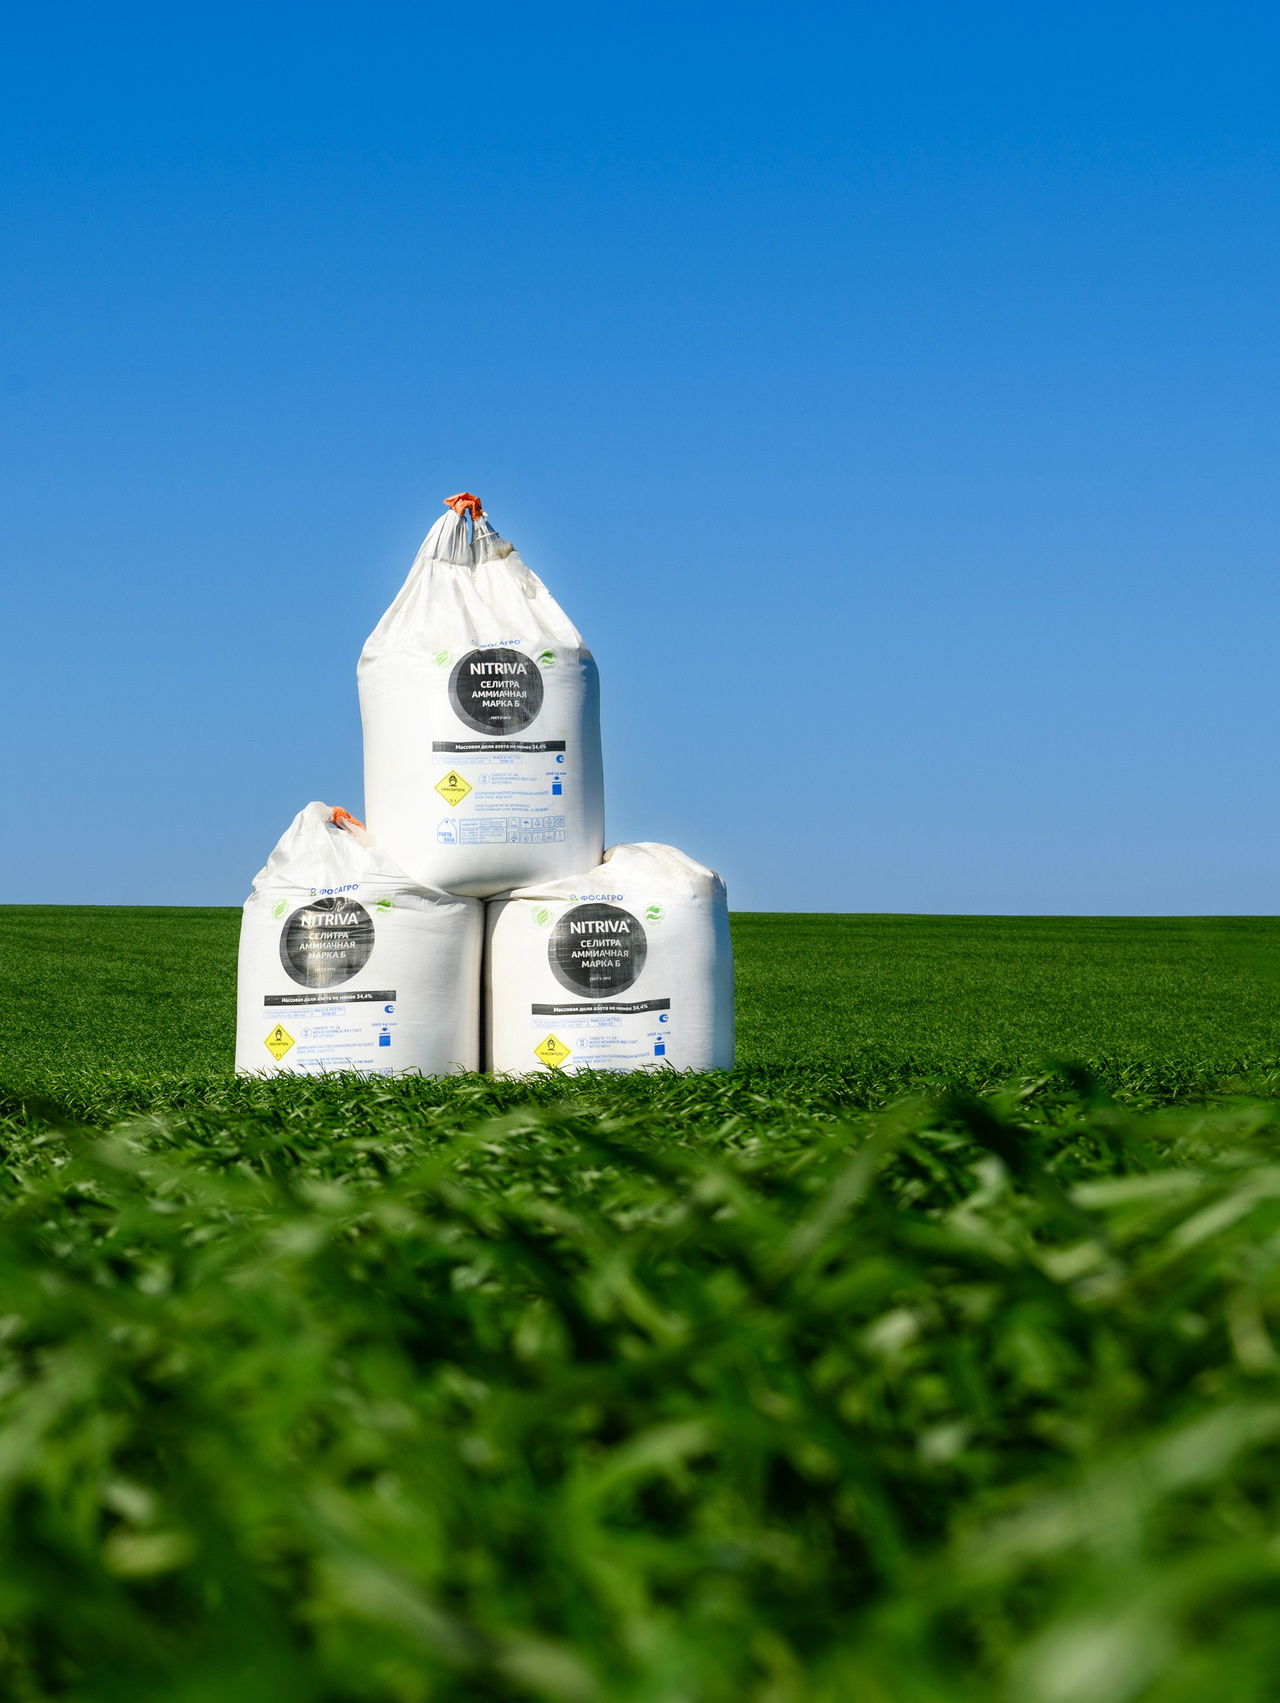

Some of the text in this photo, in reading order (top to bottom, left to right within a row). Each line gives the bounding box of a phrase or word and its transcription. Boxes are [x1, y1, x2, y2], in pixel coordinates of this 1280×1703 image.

[470, 663, 527, 675] NITRIVA
[480, 681, 520, 689] СЕЛИТРА
[472, 691, 527, 699] АММИАЧНАЯ
[482, 700, 513, 708] МАРКА
[319, 884, 359, 895] ФОСАГРО
[301, 912, 359, 927] NITRIVA
[570, 920, 630, 934] NITRIVA
[309, 931, 349, 940] СЕЛИТРА
[299, 941, 356, 950] АММИАЧНАЯ
[580, 939, 621, 948] СЕЛИТРА
[571, 950, 629, 958] АММИАЧНАЯ
[581, 960, 613, 968] МАРКА
